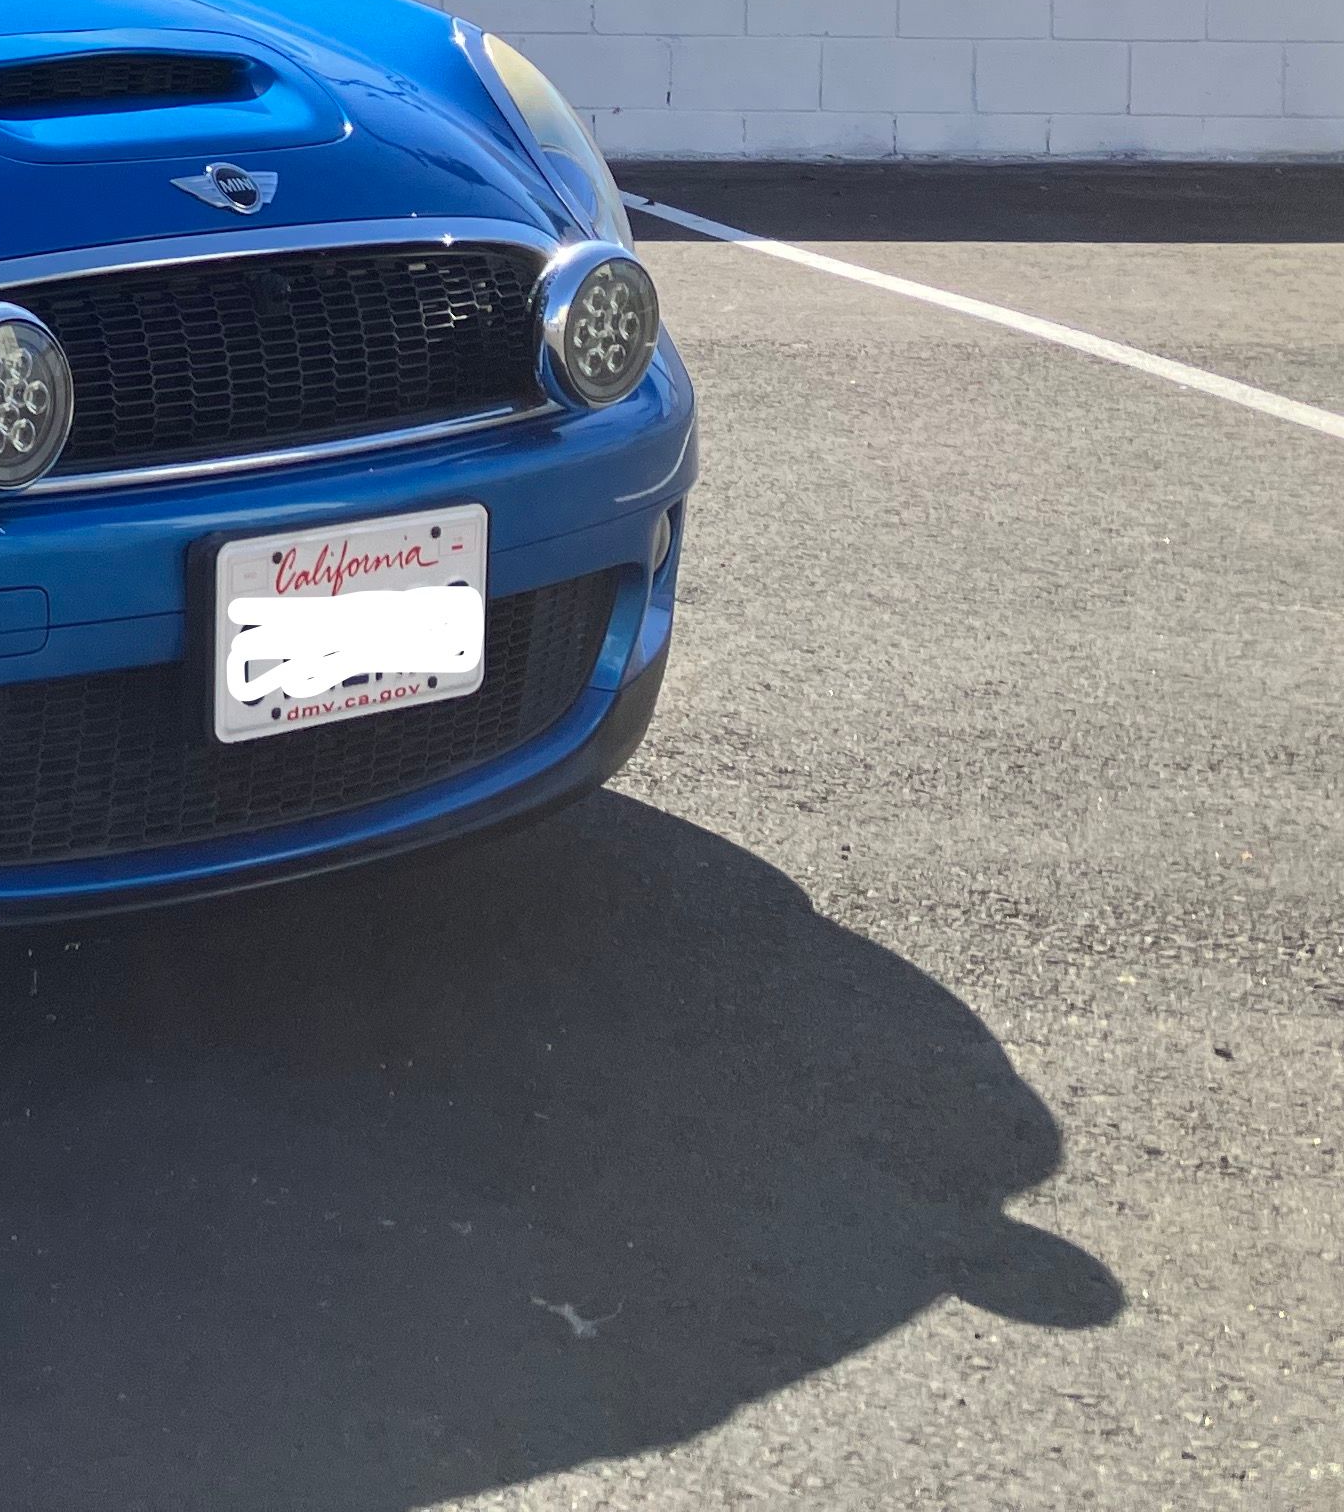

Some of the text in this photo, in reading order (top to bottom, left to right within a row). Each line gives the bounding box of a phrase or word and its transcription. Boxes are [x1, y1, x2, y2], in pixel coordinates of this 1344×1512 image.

[218, 177, 257, 193] MINI
[275, 540, 439, 597] California
[286, 682, 421, 722] dmv.ca.gov
